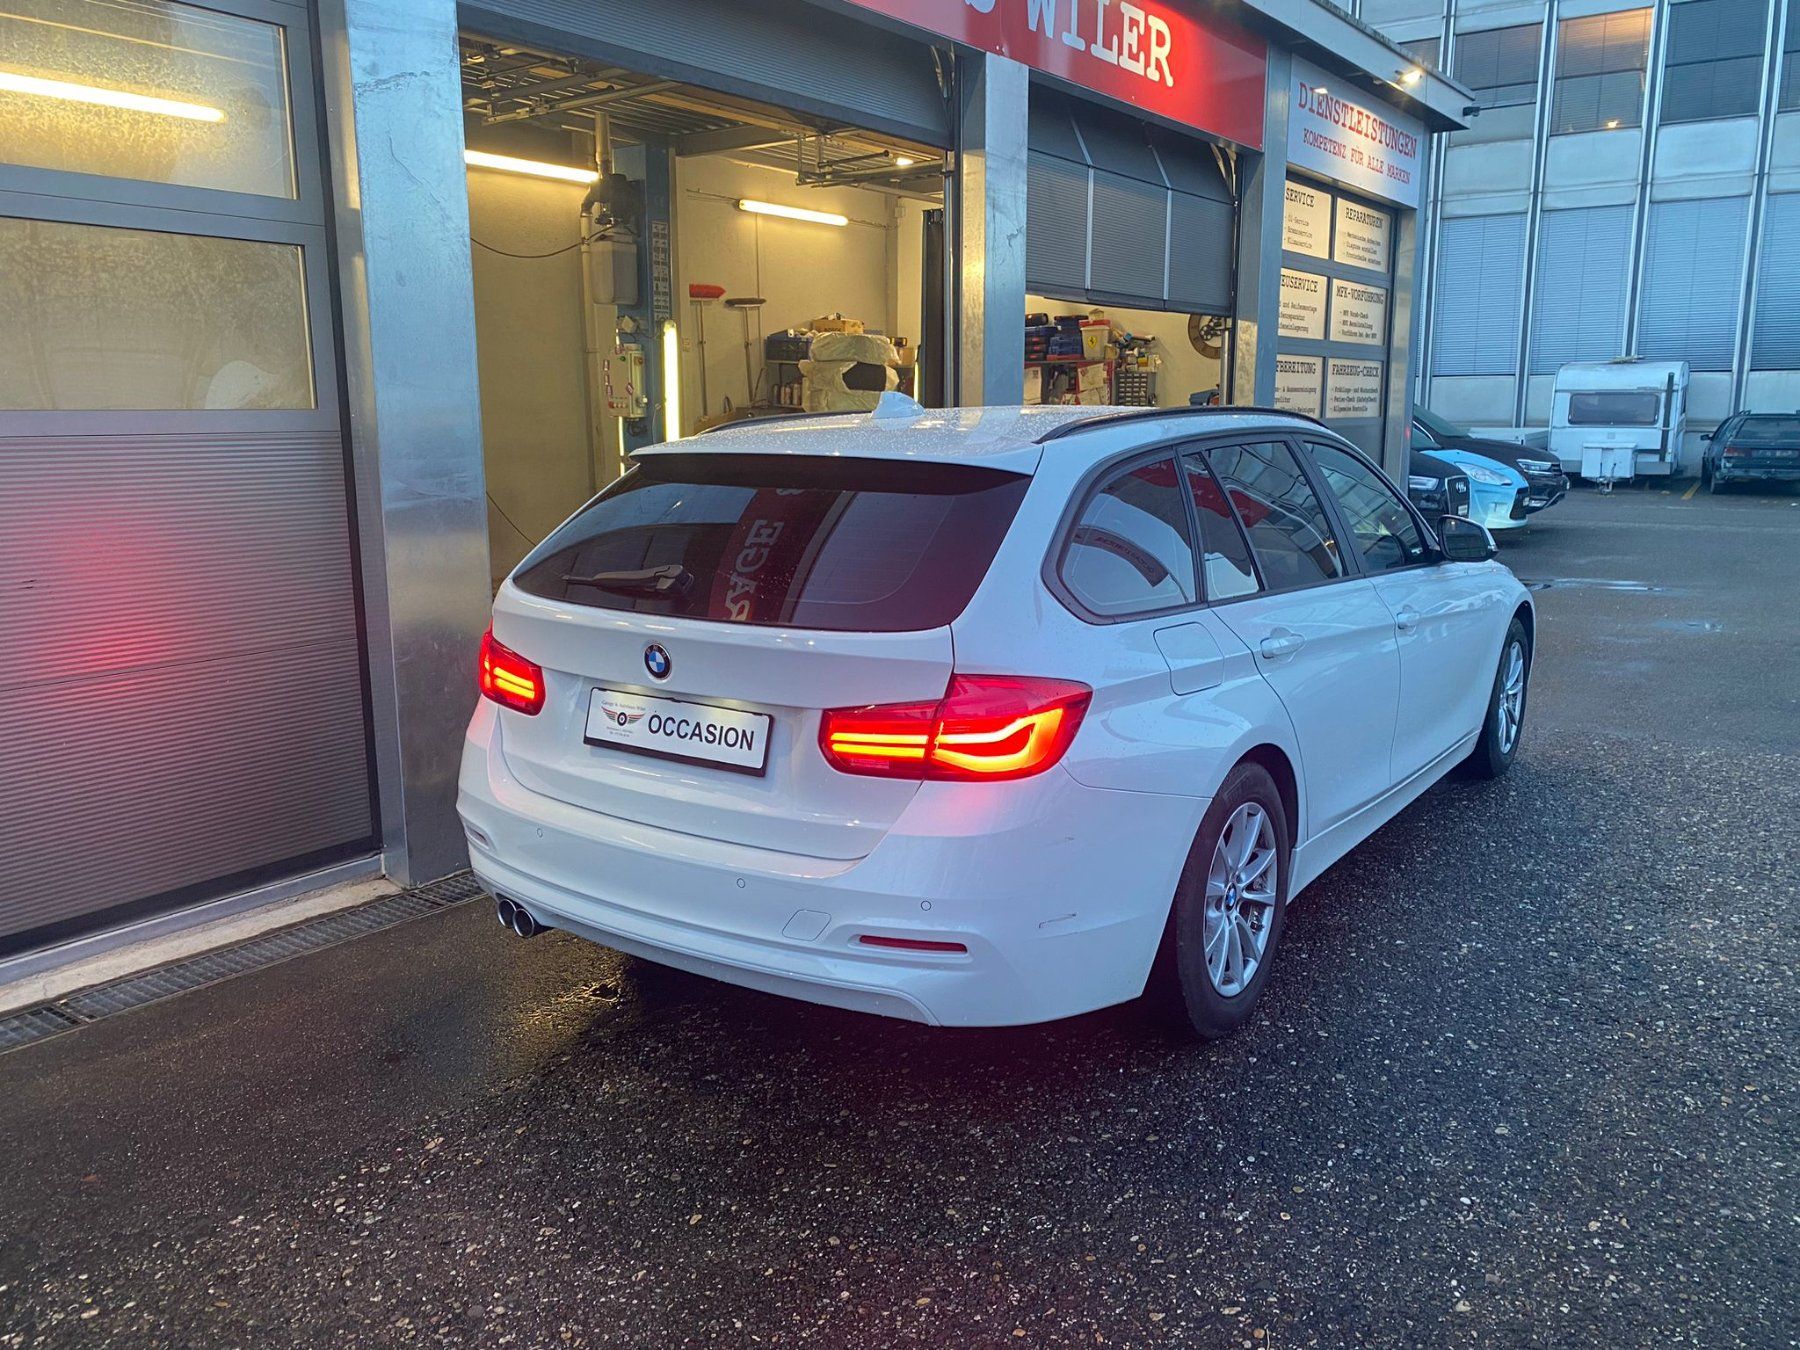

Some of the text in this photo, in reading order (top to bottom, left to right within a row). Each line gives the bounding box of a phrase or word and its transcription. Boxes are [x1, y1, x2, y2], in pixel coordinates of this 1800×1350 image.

[1026, 0, 1175, 88] WILER
[1298, 82, 1417, 160] DIENSTLEISTUNGEN
[1303, 128, 1411, 185] KOMPETENZ FÜR ALLE MARKEN
[1285, 188, 1315, 208] SERVICE
[1345, 207, 1384, 229] REPARATUREN
[1332, 364, 1379, 378] FAHRZEUG-CHECK
[648, 713, 755, 751] OCCASION
